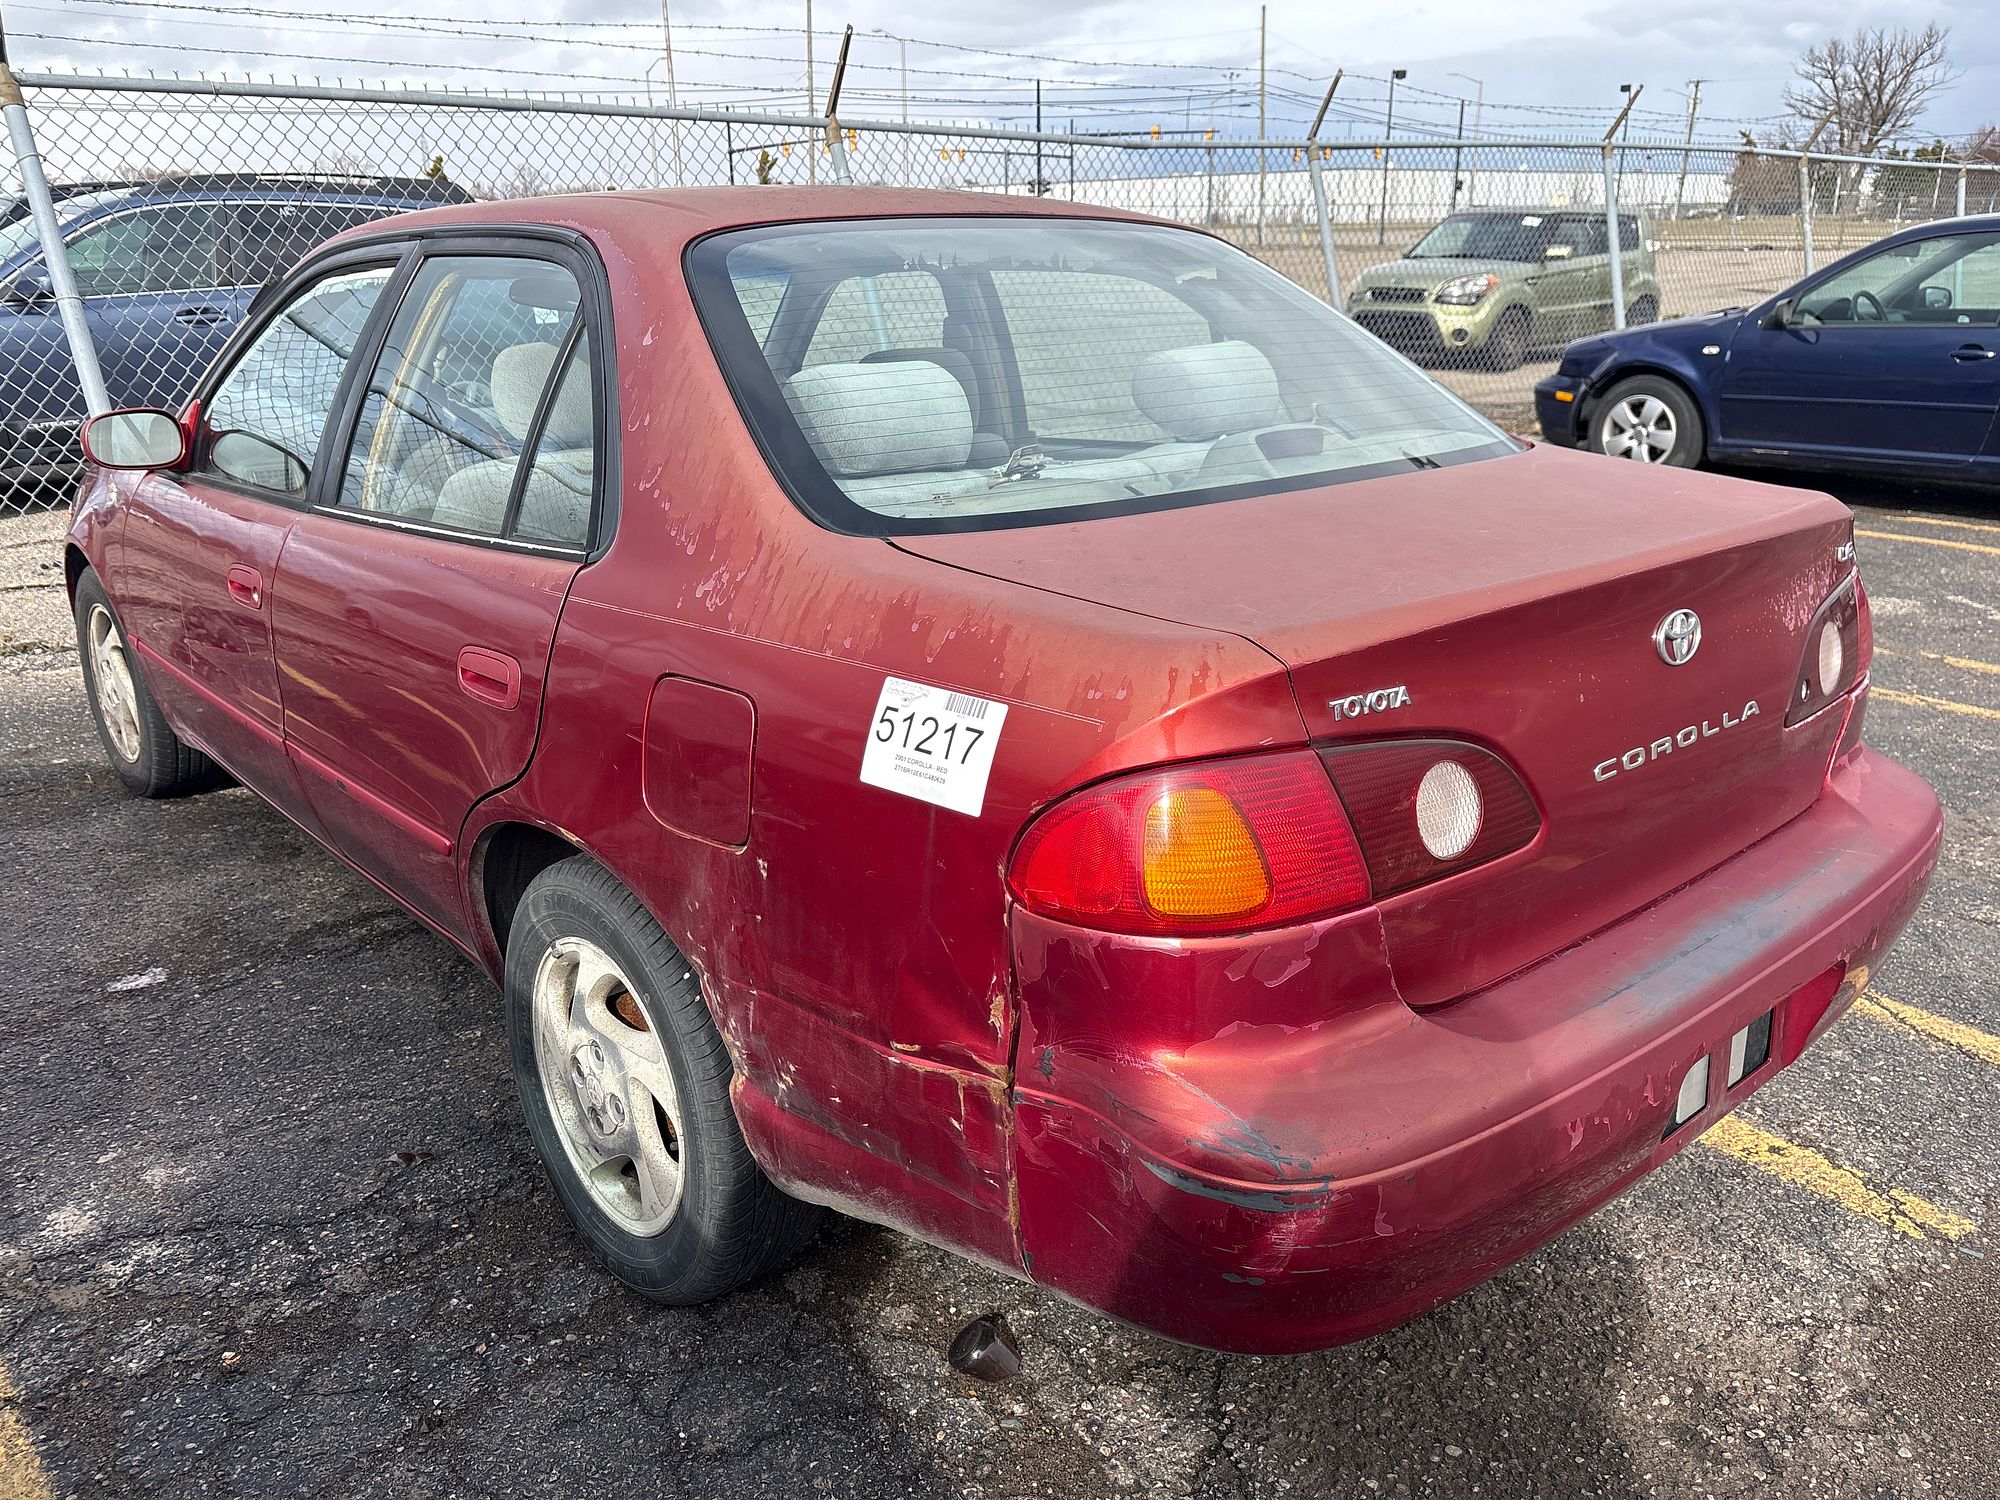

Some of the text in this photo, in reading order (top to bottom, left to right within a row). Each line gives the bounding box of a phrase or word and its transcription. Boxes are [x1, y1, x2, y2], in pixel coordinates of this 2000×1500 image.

[1329, 685, 1412, 722] TOYOTA
[876, 706, 985, 765] 51217
[1593, 699, 1761, 783] COROLLA
[894, 753, 907, 763] 2001
[907, 757, 933, 771] COROLLA
[936, 765, 948, 774] RED
